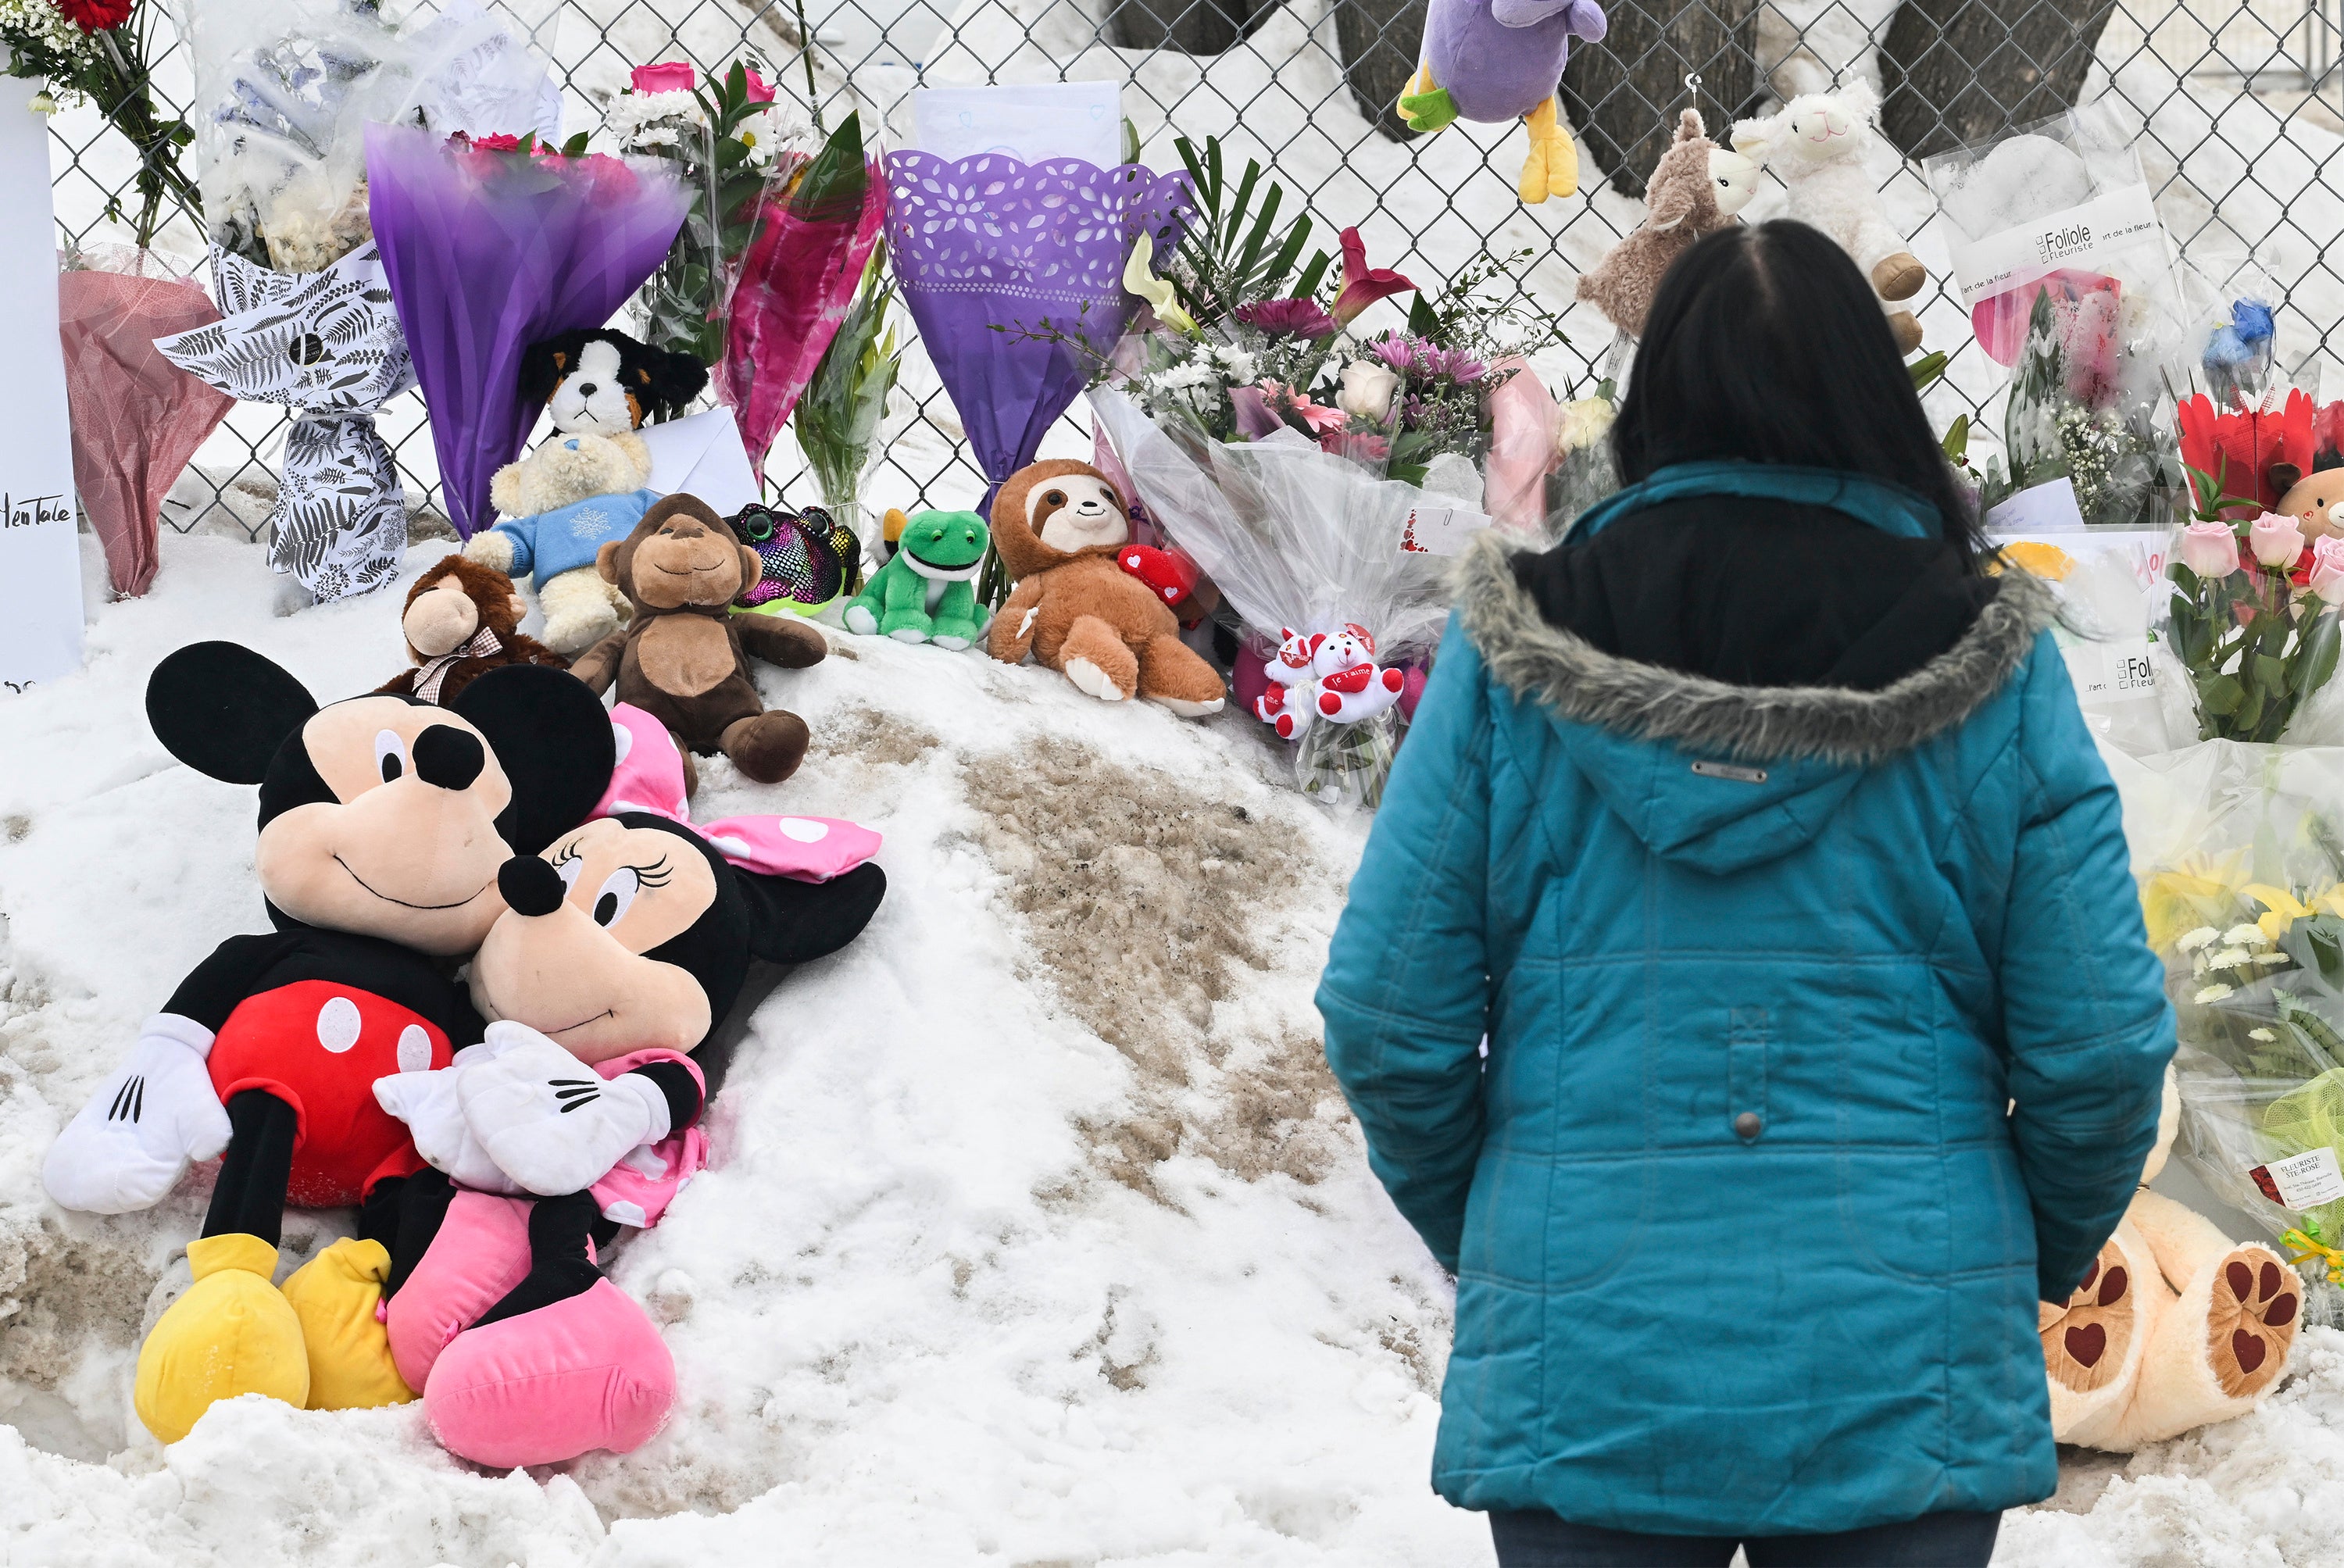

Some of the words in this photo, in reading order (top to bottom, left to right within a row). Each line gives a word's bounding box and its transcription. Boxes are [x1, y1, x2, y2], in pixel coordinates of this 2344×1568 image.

[2045, 223, 2092, 252] Foliole
[2113, 228, 2123, 237] de
[2125, 224, 2132, 234] la
[2134, 221, 2151, 233] fleur
[1995, 270, 2012, 282] fleur
[1331, 677, 1342, 688] Je
[1342, 668, 1370, 679] T'aime
[2281, 1155, 2321, 1173] FLEURISTE
[2286, 1162, 2321, 1178] STE-ROSE
